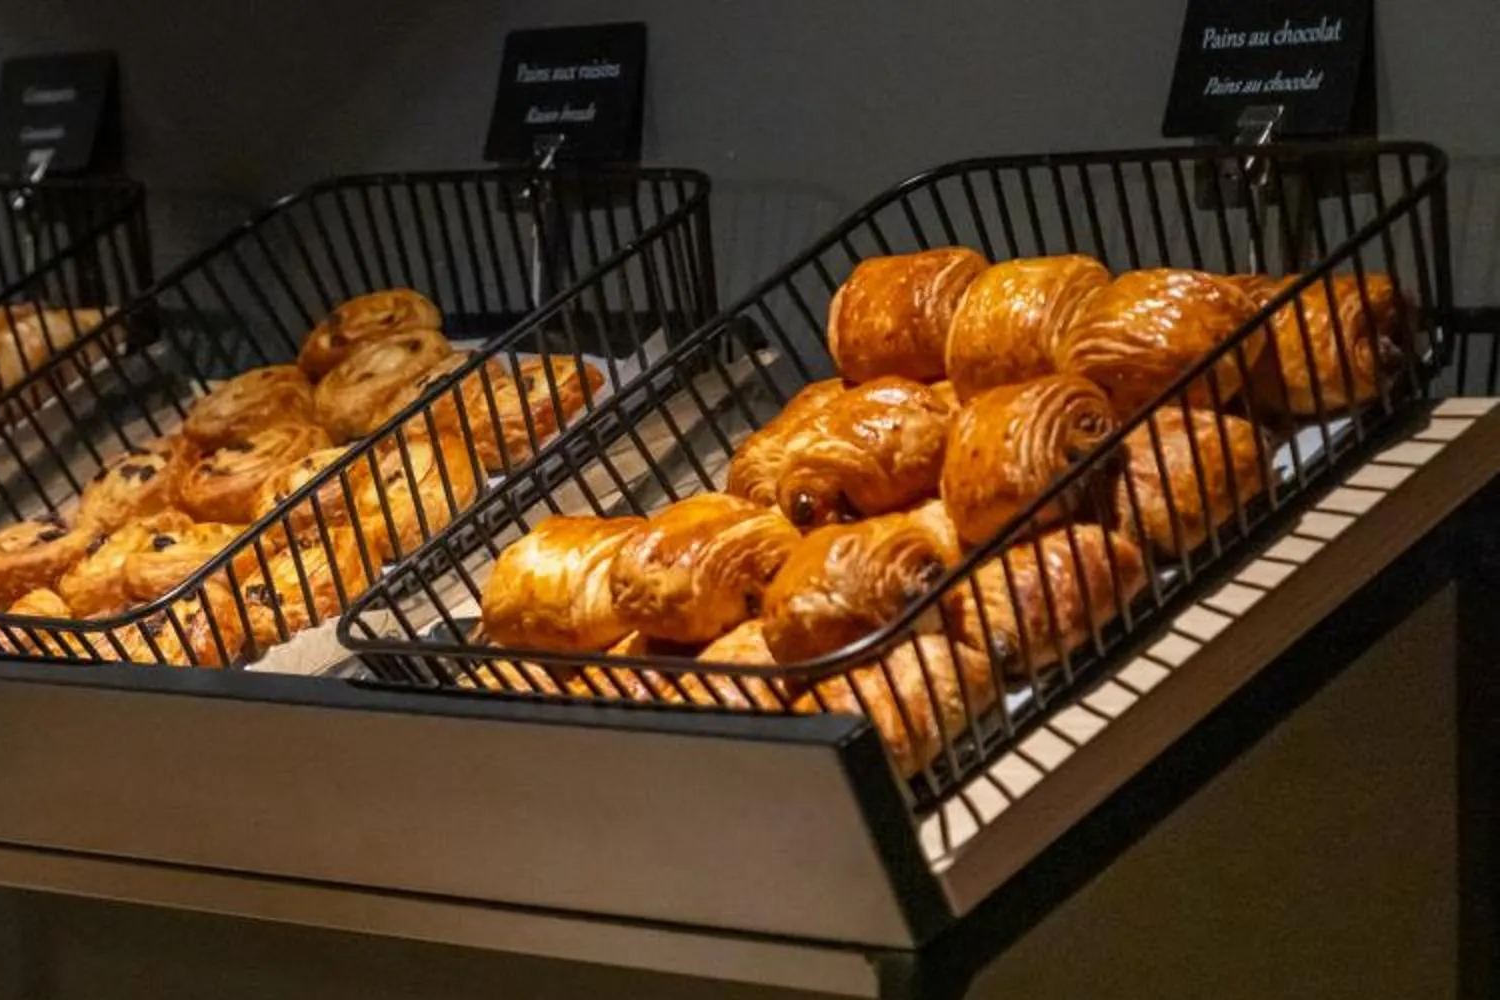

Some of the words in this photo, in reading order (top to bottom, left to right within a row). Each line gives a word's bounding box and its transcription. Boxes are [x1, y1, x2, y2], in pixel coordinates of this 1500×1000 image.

[1203, 27, 1246, 49] Pains
[1249, 32, 1270, 45] au
[1273, 16, 1342, 45] chocolat
